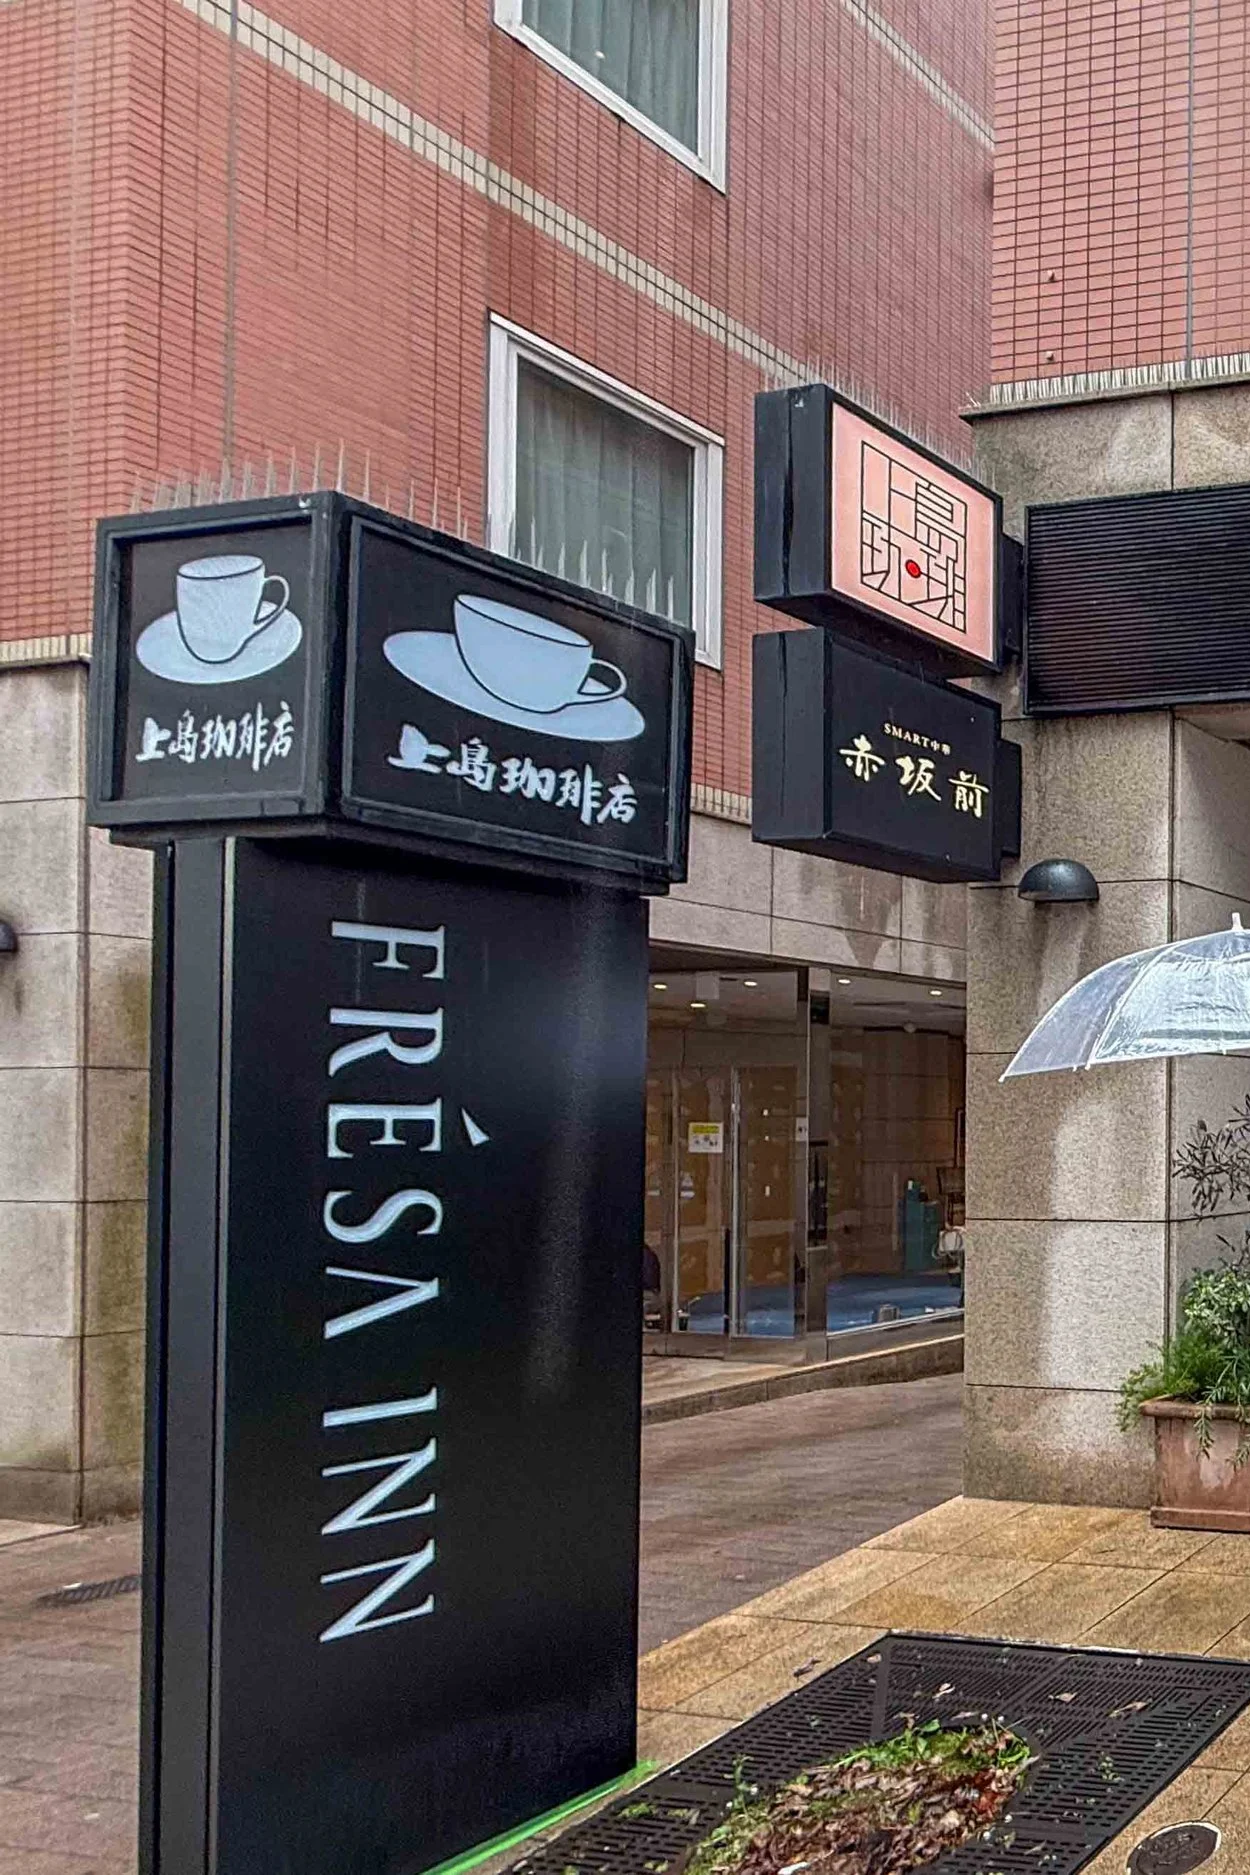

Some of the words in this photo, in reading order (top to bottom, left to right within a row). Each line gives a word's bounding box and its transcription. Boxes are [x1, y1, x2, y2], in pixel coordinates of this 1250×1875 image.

[135, 701, 295, 771] 上島珈琲店
[387, 723, 638, 827] 上島珈琲店
[839, 733, 990, 818] 赤坂前
[322, 920, 489, 1340] FRÉSA
[319, 1386, 437, 1643] INN
